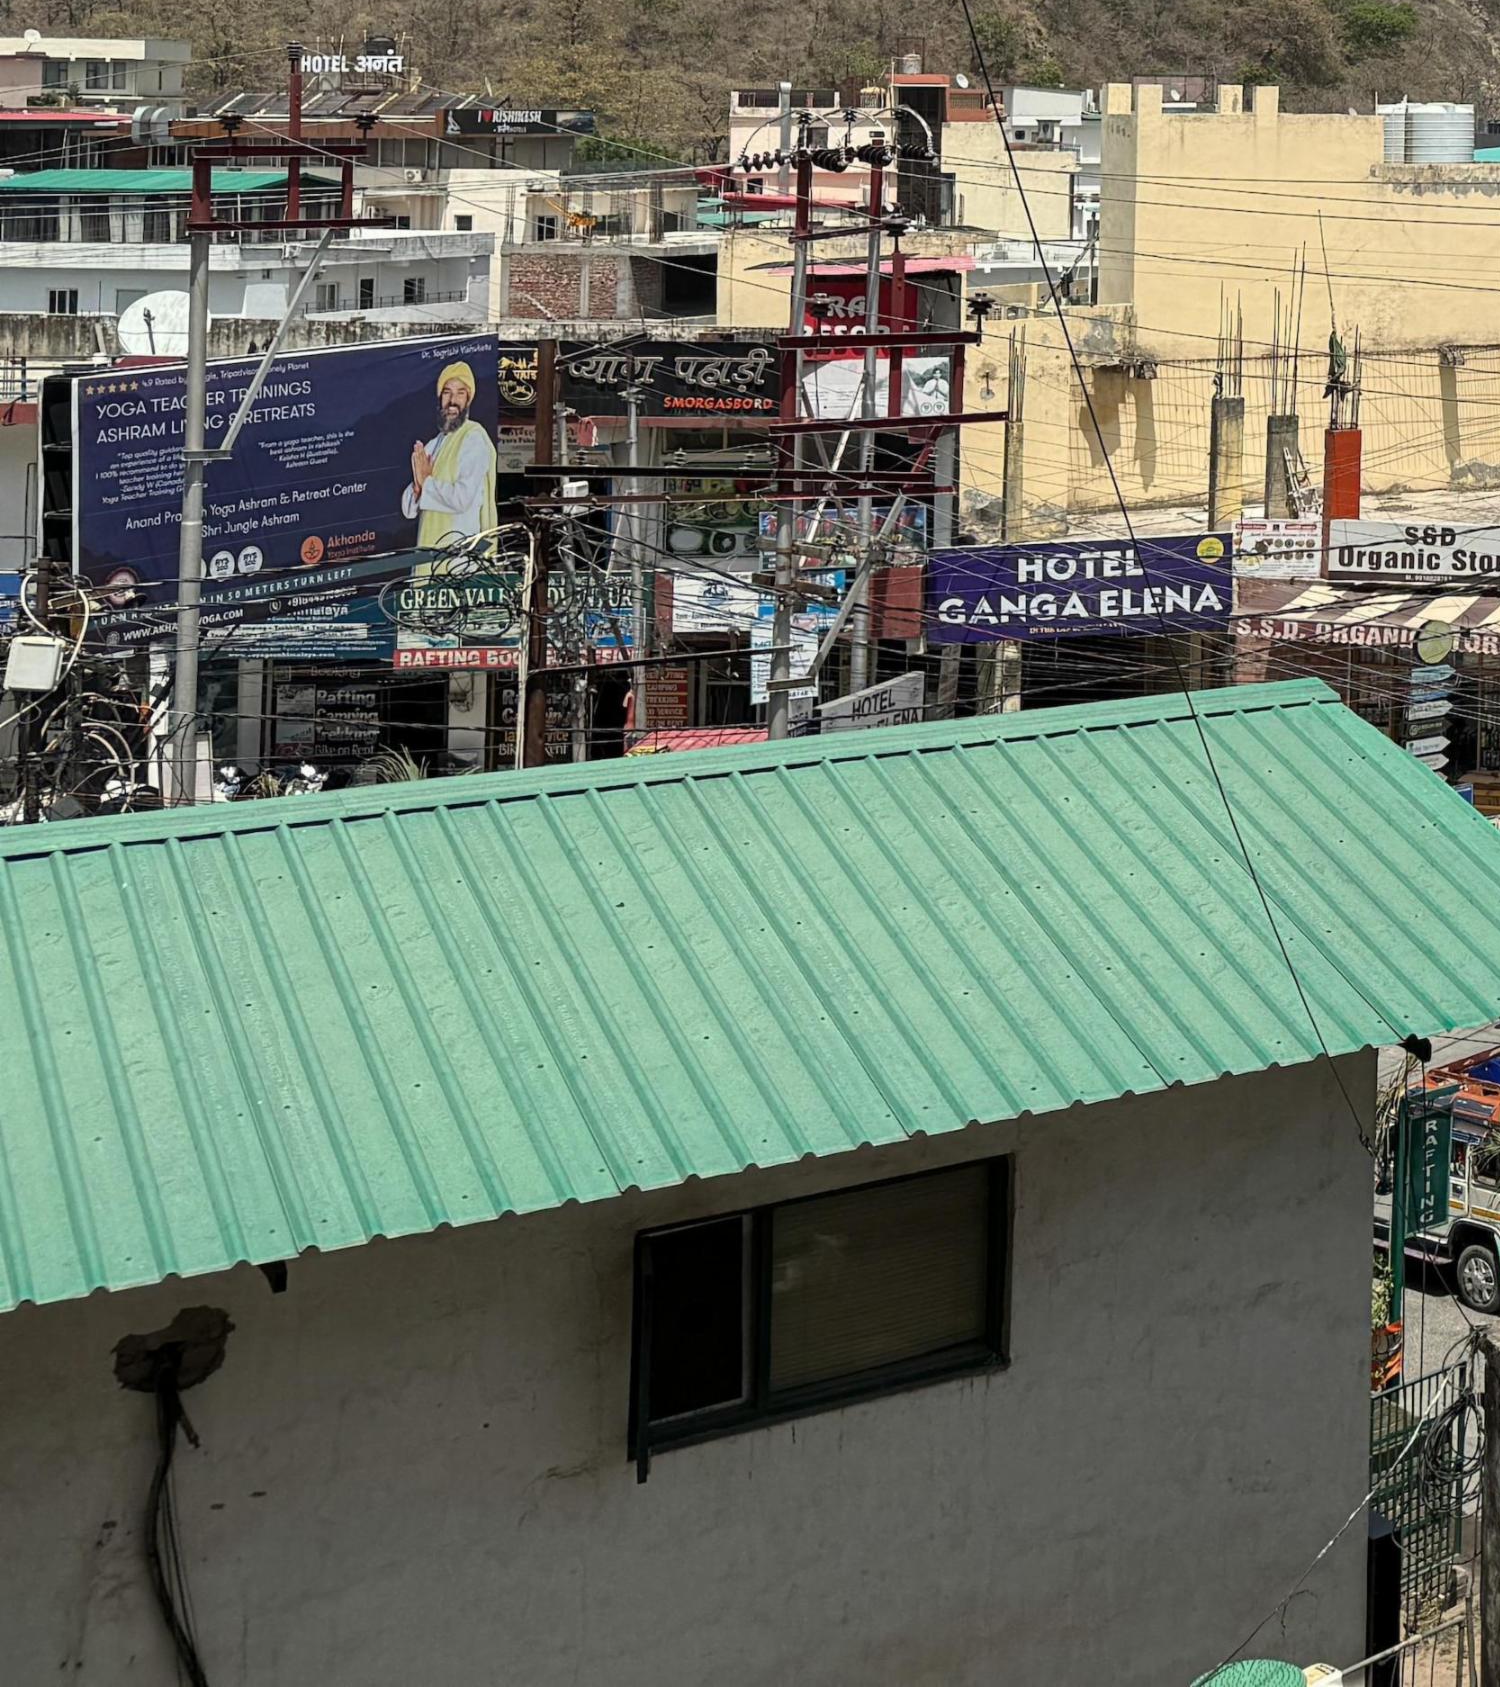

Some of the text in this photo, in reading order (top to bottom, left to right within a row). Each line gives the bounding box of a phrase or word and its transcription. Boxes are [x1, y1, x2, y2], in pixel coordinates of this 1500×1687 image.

[300, 49, 404, 73] HOTEL अनंत
[492, 110, 542, 123] RISHIKESH
[141, 362, 310, 387] 4.9 Rated Planet
[674, 348, 775, 392] पहाड़ी
[96, 400, 147, 420] YOGA
[150, 391, 225, 413] TEACER
[663, 396, 774, 410] SMORGASBORD
[96, 420, 166, 444] ASHRAM
[242, 403, 316, 425] RETREATS
[100, 471, 119, 479] 100%
[119, 465, 159, 477] recommend
[120, 458, 157, 468] experience
[119, 471, 172, 485] teacher training
[102, 487, 175, 505] Yoga Teacher Training
[125, 481, 368, 531] Anand Yoga Ashram & Retreat Center
[200, 512, 300, 539] Shri Jungle Ashram
[1404, 525, 1457, 548] SSD
[326, 529, 376, 549] Akhanda
[1017, 548, 1144, 583] HOTEL
[1338, 546, 1441, 572] Organic
[228, 590, 242, 601] 50
[244, 580, 290, 598] METERS
[293, 572, 325, 587] TURN
[327, 568, 354, 581] LEFT
[400, 587, 461, 610] GREEN
[938, 583, 1223, 626] GANGA ELENA
[399, 648, 480, 668] RAFTING
[316, 689, 376, 708] Rafting
[850, 688, 897, 721] HOTEL
[1418, 1120, 1438, 1224] RAFTING
